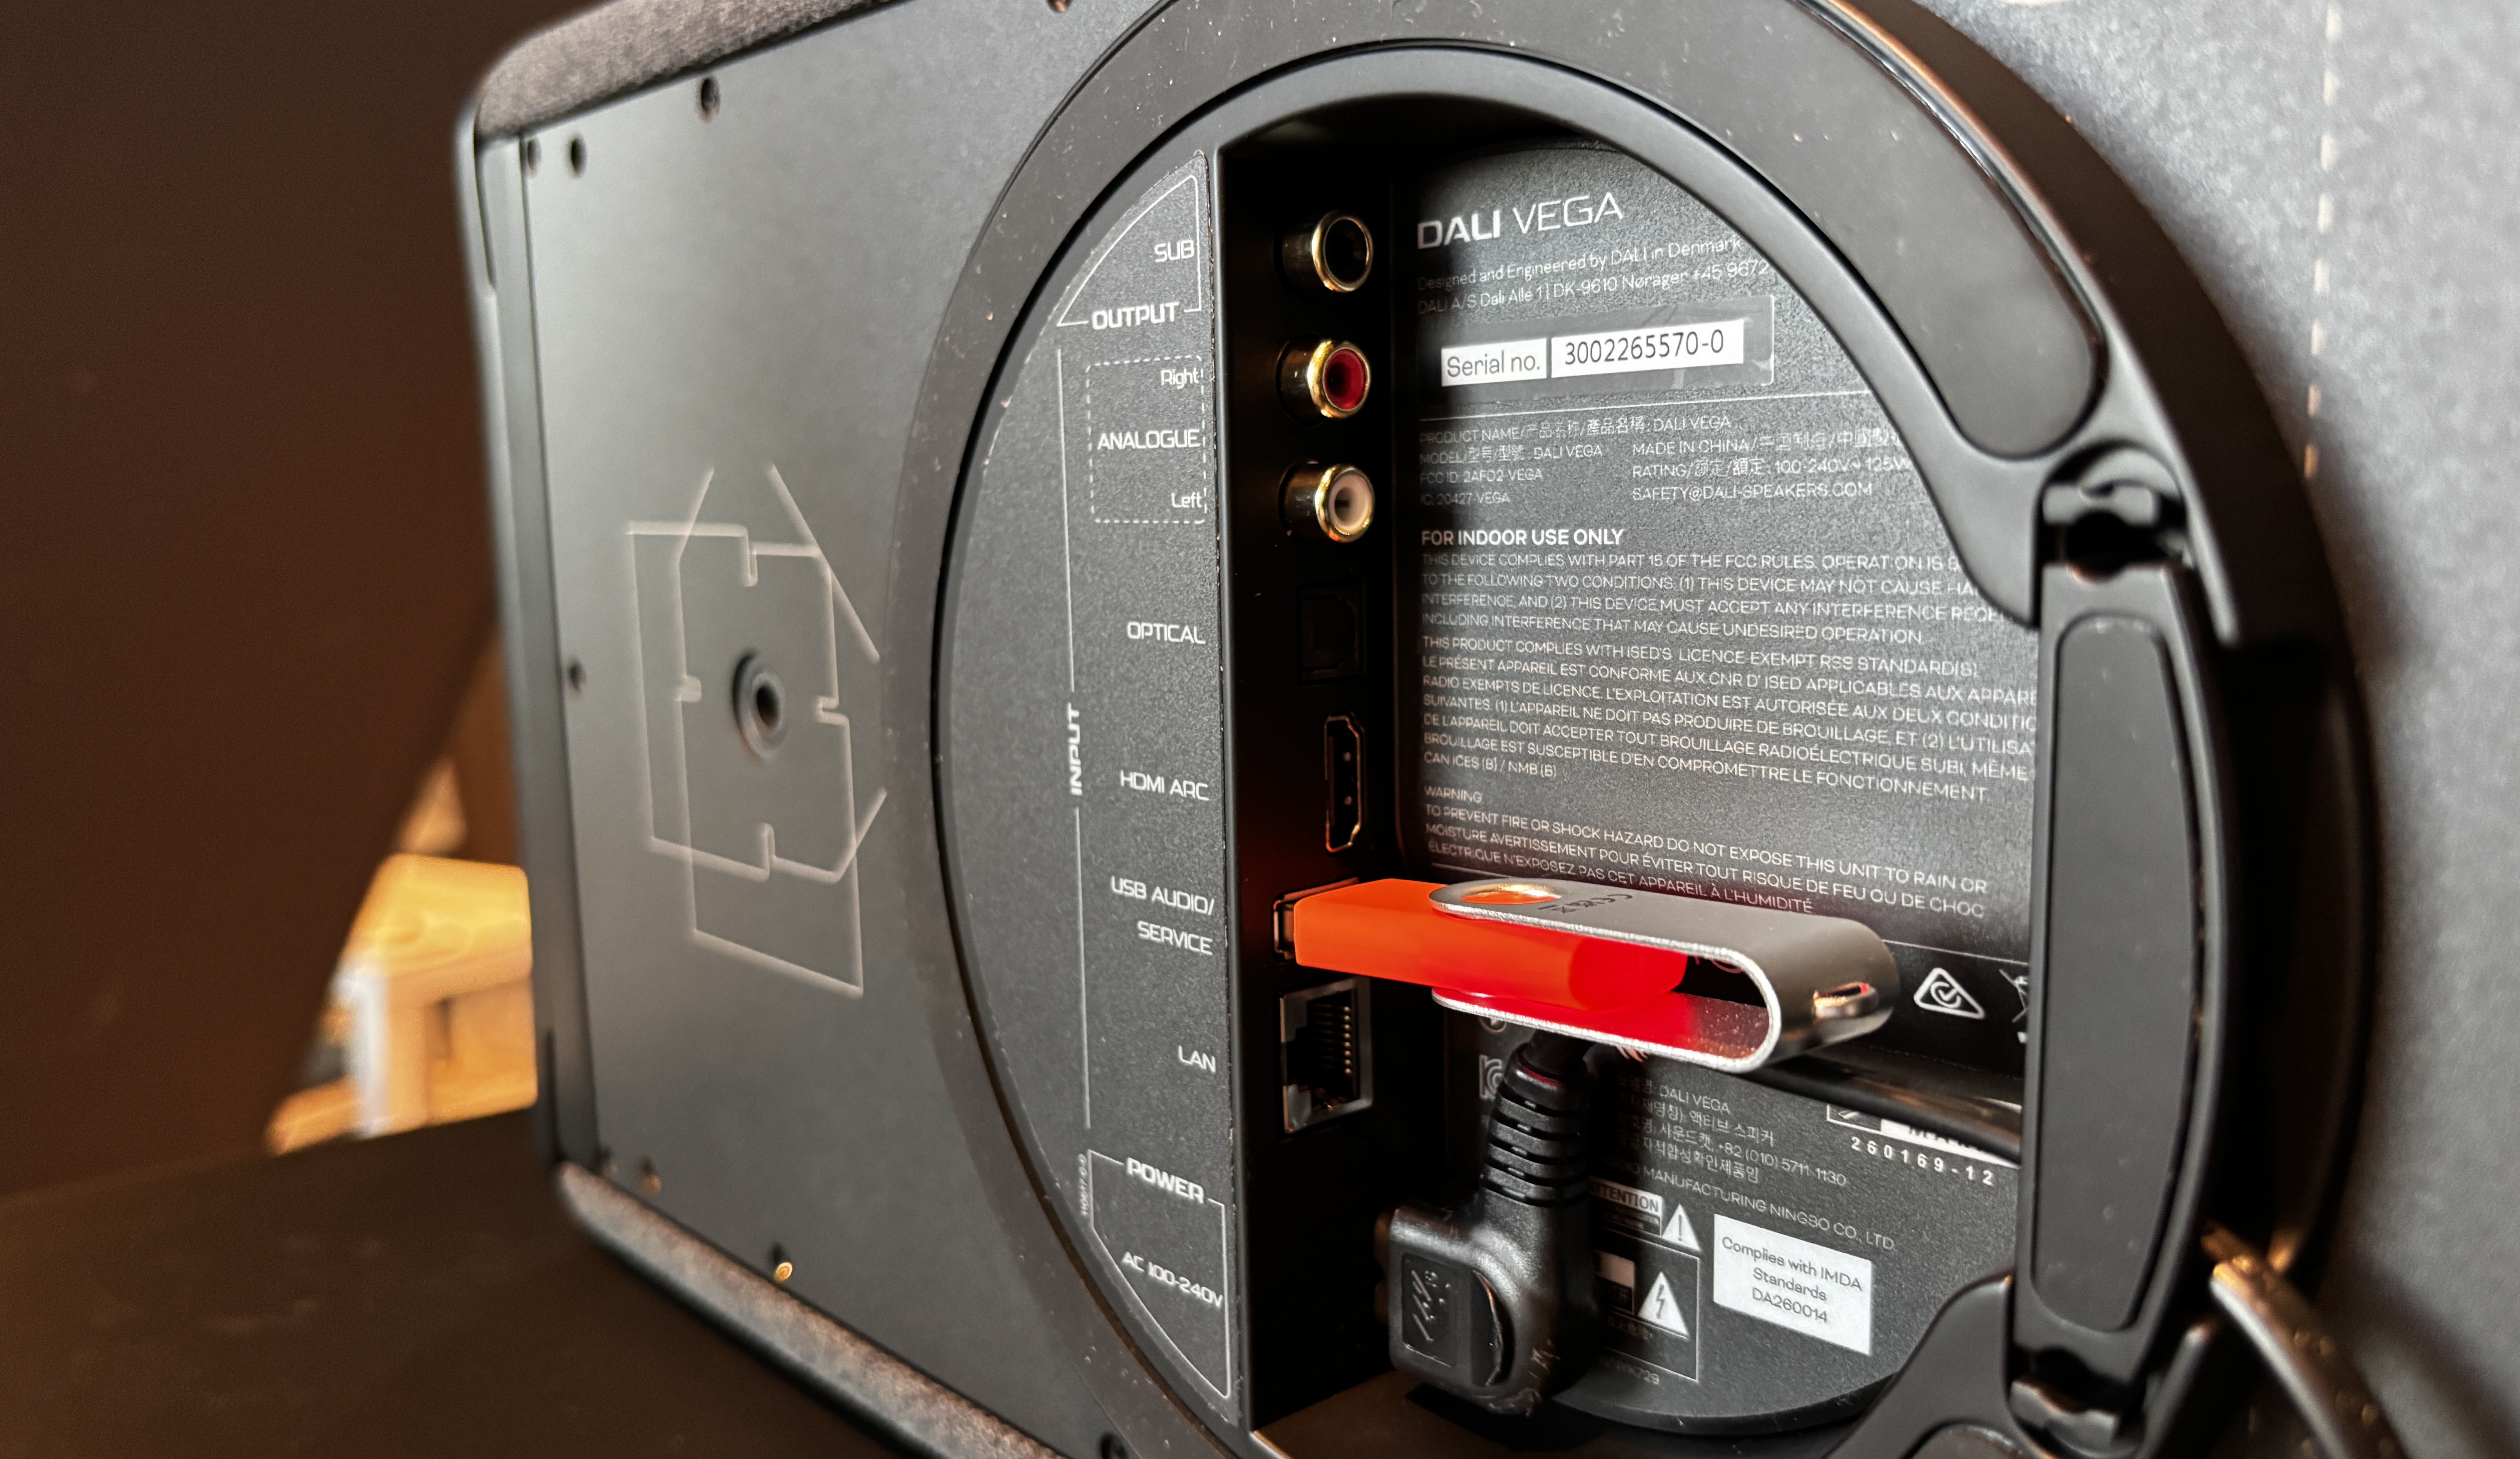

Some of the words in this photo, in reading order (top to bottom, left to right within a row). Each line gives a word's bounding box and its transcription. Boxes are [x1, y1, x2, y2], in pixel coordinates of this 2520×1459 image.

[1417, 210, 1500, 249] DALI
[1513, 192, 1623, 235] VEGA
[1154, 239, 1195, 262] SUB
[1418, 270, 1475, 293] Designed
[1480, 266, 1503, 282] and
[1507, 258, 1586, 281] Engineered
[1611, 248, 1646, 264] DALI
[1668, 237, 1741, 257] Denmark
[1451, 296, 1476, 310] A/S
[1510, 288, 1533, 303] Alle
[1553, 277, 1617, 297] DK-9610
[1623, 268, 1687, 294] Nørager
[1092, 302, 1179, 330] OUTPUT
[1447, 350, 1505, 377] Serial
[1511, 354, 1541, 372] no.
[1564, 329, 1725, 365] 3002265570-0
[1160, 368, 1200, 389] Right
[1097, 429, 1201, 450] ANALOGUE
[1420, 430, 1478, 443] PRODUCT
[1653, 418, 1686, 432] DALI
[1690, 417, 1732, 430] VEGA
[1534, 447, 1562, 459] DALI
[1565, 445, 1603, 458] VEGA
[1632, 443, 1675, 456] MADE
[1171, 492, 1202, 508] Left
[1421, 530, 1454, 546] FOR
[1458, 530, 1527, 545] INDOOR
[1532, 529, 1569, 545] USE
[1573, 529, 1624, 545] ONLY
[1423, 554, 1448, 565] THIS
[1451, 554, 1497, 566] DEVICE
[1498, 555, 1564, 566] COMPLIES
[1567, 555, 1605, 567] WITH
[1609, 555, 1645, 567] PART
[1692, 555, 1723, 568] THE
[1725, 556, 1757, 568] FCC
[1822, 556, 1926, 570] OPERATION
[1441, 575, 1465, 585] THE
[1467, 575, 1543, 587] FOLLOWING
[1546, 576, 1579, 587] TWO
[1697, 578, 1733, 591] THIS
[1737, 579, 1796, 592] DEVICE
[1800, 579, 1832, 592] MAY
[1839, 580, 1873, 593] NOT
[1880, 580, 1942, 594] CAUSE
[1518, 596, 1547, 608] AND
[1570, 598, 1601, 609] THIS
[1605, 598, 1658, 610] DEVICE
[1660, 599, 1705, 613] MUST
[1708, 601, 1770, 615] ACCEPT
[1774, 603, 1807, 616] ANY
[1812, 604, 1946, 620] INTERFERENCE
[1127, 621, 1206, 644] OPTICAL
[1421, 614, 1488, 627] INCLUDING
[1492, 617, 1592, 631] INTERFERENCE
[1594, 619, 1629, 632] THAT
[1635, 620, 1664, 633] MAY
[1667, 621, 1721, 636] CAUSE
[1722, 623, 1817, 640] UNDESIRED
[1423, 636, 1450, 649] THIS
[1452, 638, 1511, 652] PRODUCT
[1515, 640, 1582, 655] COMPLIES
[1586, 644, 1624, 658] WITH
[1627, 646, 1672, 660] ISED'S
[1821, 655, 1853, 670] RSS
[1439, 655, 1494, 672] PRÉSENT
[1497, 661, 1558, 676] APPAREIL
[1560, 665, 1586, 678] EST
[1589, 666, 1671, 682] CONFORME
[1674, 669, 1705, 684] AUX
[1709, 672, 1743, 687] CNR
[1765, 675, 1801, 690] ISED
[1806, 678, 1920, 698] APPLICABLES
[1925, 684, 1963, 701] AUX
[1422, 676, 1460, 689] RADIO
[1462, 678, 1519, 693] EXEMPTS
[1606, 687, 1718, 707] L'EXPLOITATION
[1722, 694, 1751, 709] EST
[1755, 694, 1849, 717] AUTORISÉE
[1852, 703, 1886, 720] AUX
[1892, 706, 1944, 723] DEUX
[1511, 700, 1579, 718] L'APPAREIL
[1605, 708, 1639, 723] DOIT
[1643, 711, 1671, 725] PAS
[1674, 713, 1753, 732] PRODUIRE
[1067, 702, 1083, 796] INPUT
[1423, 752, 1450, 766] CAN
[1452, 755, 1479, 770] ICES
[1508, 760, 1538, 775] NMB
[1442, 715, 1508, 732] L'APPAREIL
[1510, 720, 1541, 735] DOIT
[1543, 723, 1614, 742] ACCEPTER
[1619, 730, 1656, 745] TOUT
[1660, 734, 1755, 755] BROUILLAGE
[1759, 742, 1916, 771] RADIOÉLECTRIQUE
[1972, 760, 2030, 781] MÊME
[1423, 733, 1498, 751] BROUILLAGE
[1500, 739, 1523, 753] EST
[1527, 742, 1618, 763] SUSCEPTIBLE
[1621, 752, 1654, 768] D'EN
[1657, 757, 1789, 782] COMPROMETTRE
[1816, 770, 1988, 803] FONCTIONNEMENT
[1121, 770, 1165, 793] HDMI
[1170, 779, 1209, 801] ARC
[1425, 785, 1482, 802] WARNING
[1443, 806, 1497, 825] PREVENT
[1501, 813, 1528, 829] FIRE
[1552, 819, 1601, 839] SHOCK
[1604, 826, 1664, 849] HAZARD
[1694, 840, 1728, 858] NOT
[1729, 845, 1792, 867] EXPOSE
[1799, 855, 1834, 873] THIS
[1839, 861, 1878, 879] UNIT
[1913, 871, 1956, 890] RAIN
[1425, 823, 1487, 842] MOISTURE
[1489, 831, 1598, 859] AVERTISSEMENT
[1600, 847, 1638, 865] POUR
[1642, 851, 1692, 873] ÉVITER
[1695, 862, 1737, 880] TOUT
[1743, 869, 1804, 891] RISQUE
[1832, 882, 1866, 901] FEU
[1929, 895, 1984, 918] CHOC
[1504, 852, 1575, 875] N'EXPOSEZ
[1579, 863, 1605, 879] PAS
[1607, 868, 1635, 884] CET
[1639, 872, 1707, 896] APPAREIL
[1724, 888, 1813, 913] L'HUMIDITÉ
[1111, 876, 1147, 900] USB
[1151, 886, 1215, 915] AUDIO/
[1137, 920, 1213, 955] SERVICE
[1178, 1045, 1216, 1074] LAN
[1659, 1085, 1688, 1104] DALI
[1692, 1094, 1731, 1115] VEGA
[1733, 1121, 1774, 1147] 스피커
[1745, 1146, 1778, 1166] (010)
[1126, 1157, 1204, 1204] POWER
[1643, 1166, 1766, 1212] MANUFACTURING
[1769, 1200, 1830, 1230] NINGBO
[1121, 1251, 1144, 1272] AC
[1148, 1261, 1224, 1308] 100-240V
[1721, 1236, 1785, 1266] Complies
[1788, 1252, 1816, 1275] with
[1820, 1266, 1862, 1291] IMDA
[1752, 1267, 1827, 1302] Standards
[1751, 1287, 1828, 1324] DA260014
